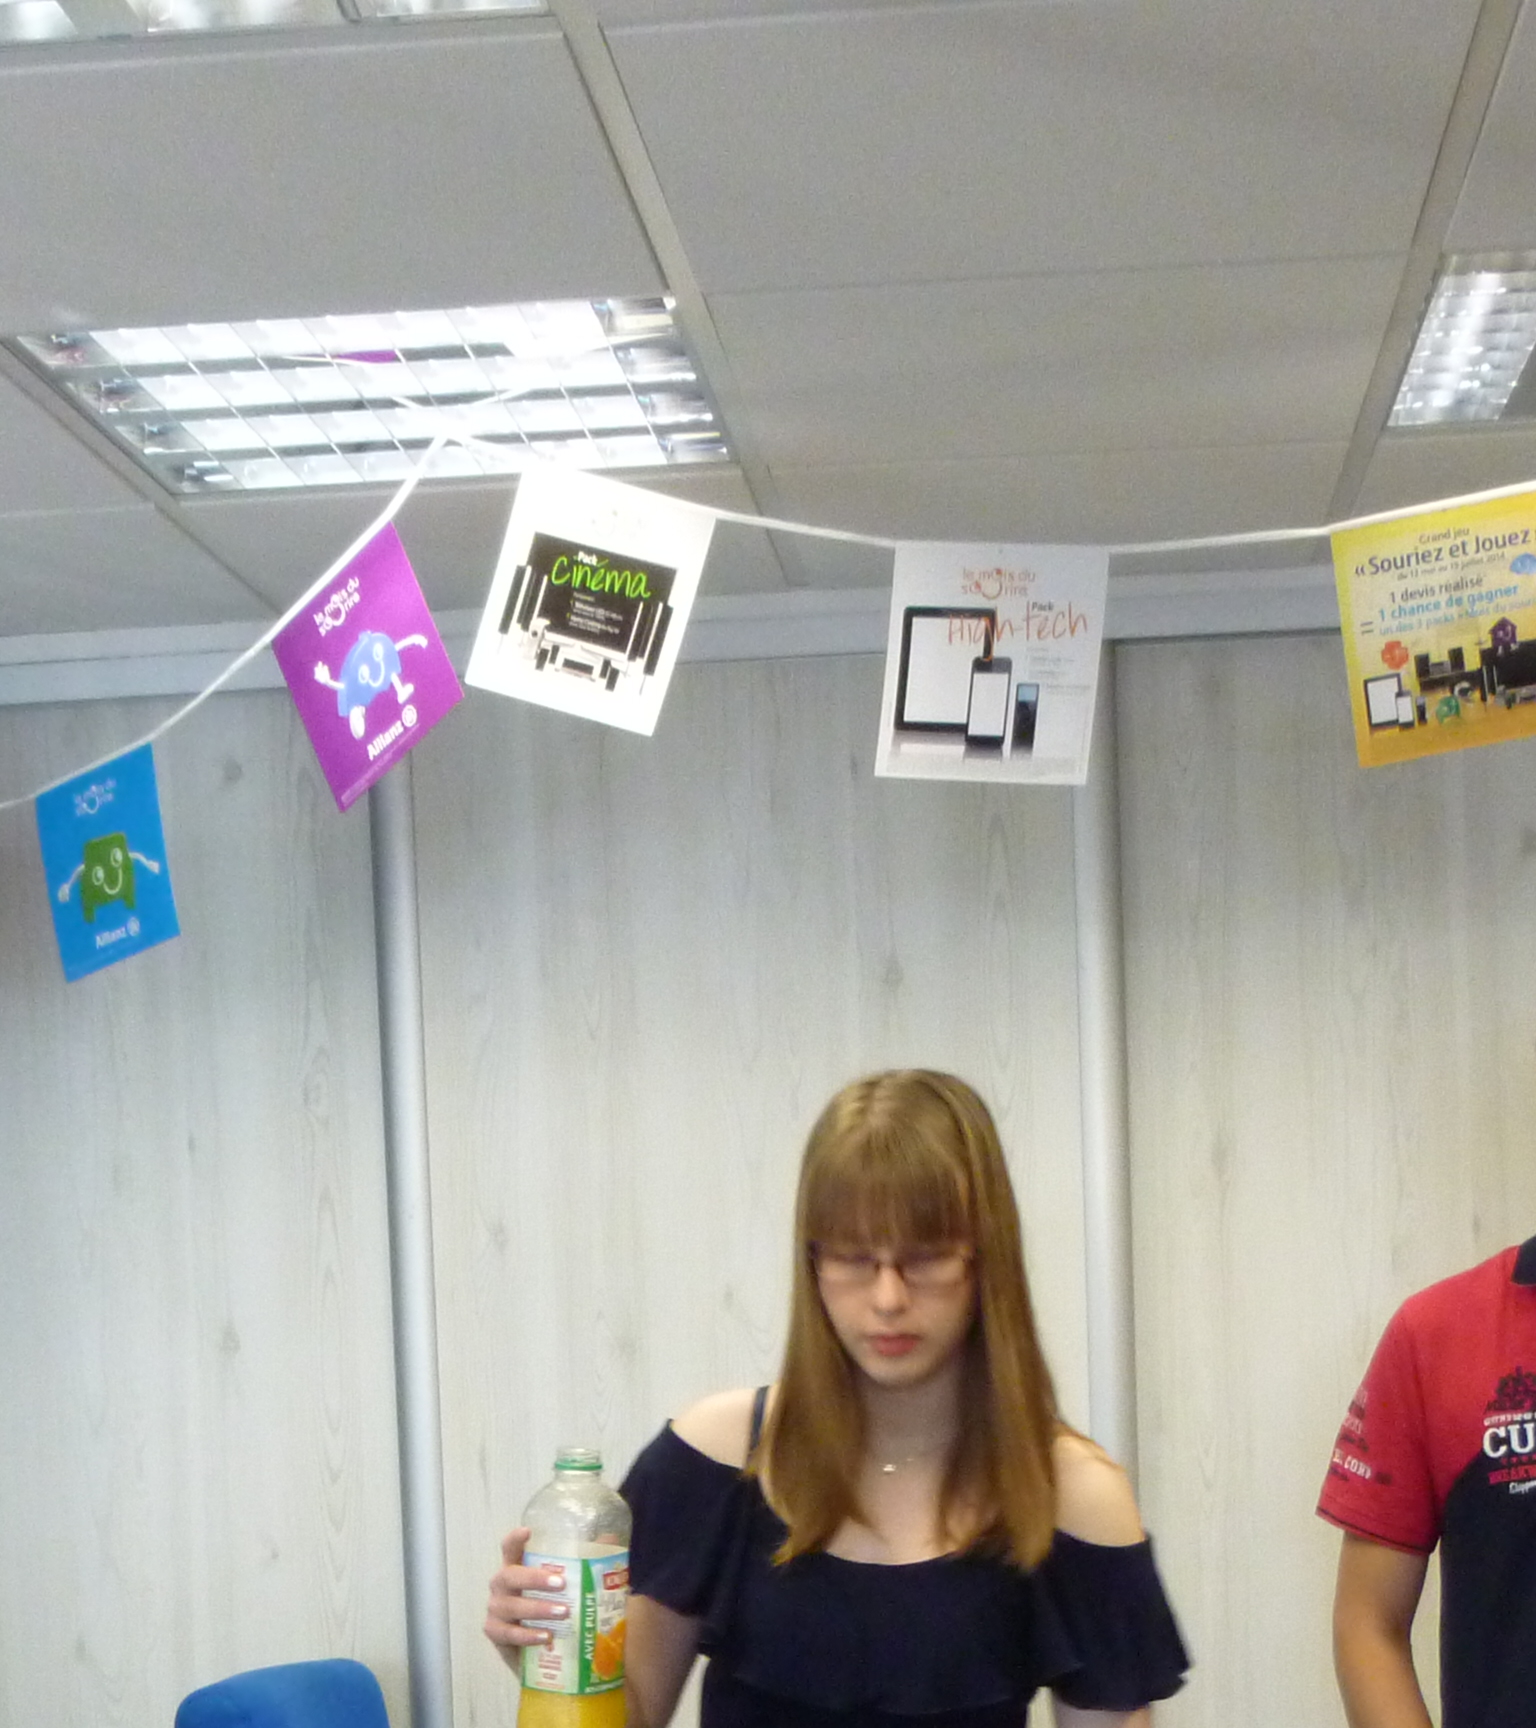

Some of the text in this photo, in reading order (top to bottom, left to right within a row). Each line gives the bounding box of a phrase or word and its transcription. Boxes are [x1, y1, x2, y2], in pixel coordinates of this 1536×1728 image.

[1419, 526, 1470, 544] Grand jeu
[577, 551, 598, 566] Pack
[1368, 546, 1444, 575] Souriez
[1449, 541, 1469, 558] et
[1475, 528, 1531, 554] Jouez
[1391, 599, 1441, 619] chance
[1445, 594, 1464, 610] de
[1467, 585, 1519, 608] gagner
[1401, 583, 1436, 602] devis
[1031, 601, 1054, 612] Pack
[367, 719, 405, 761] Allianz
[96, 926, 127, 949] Allianz
